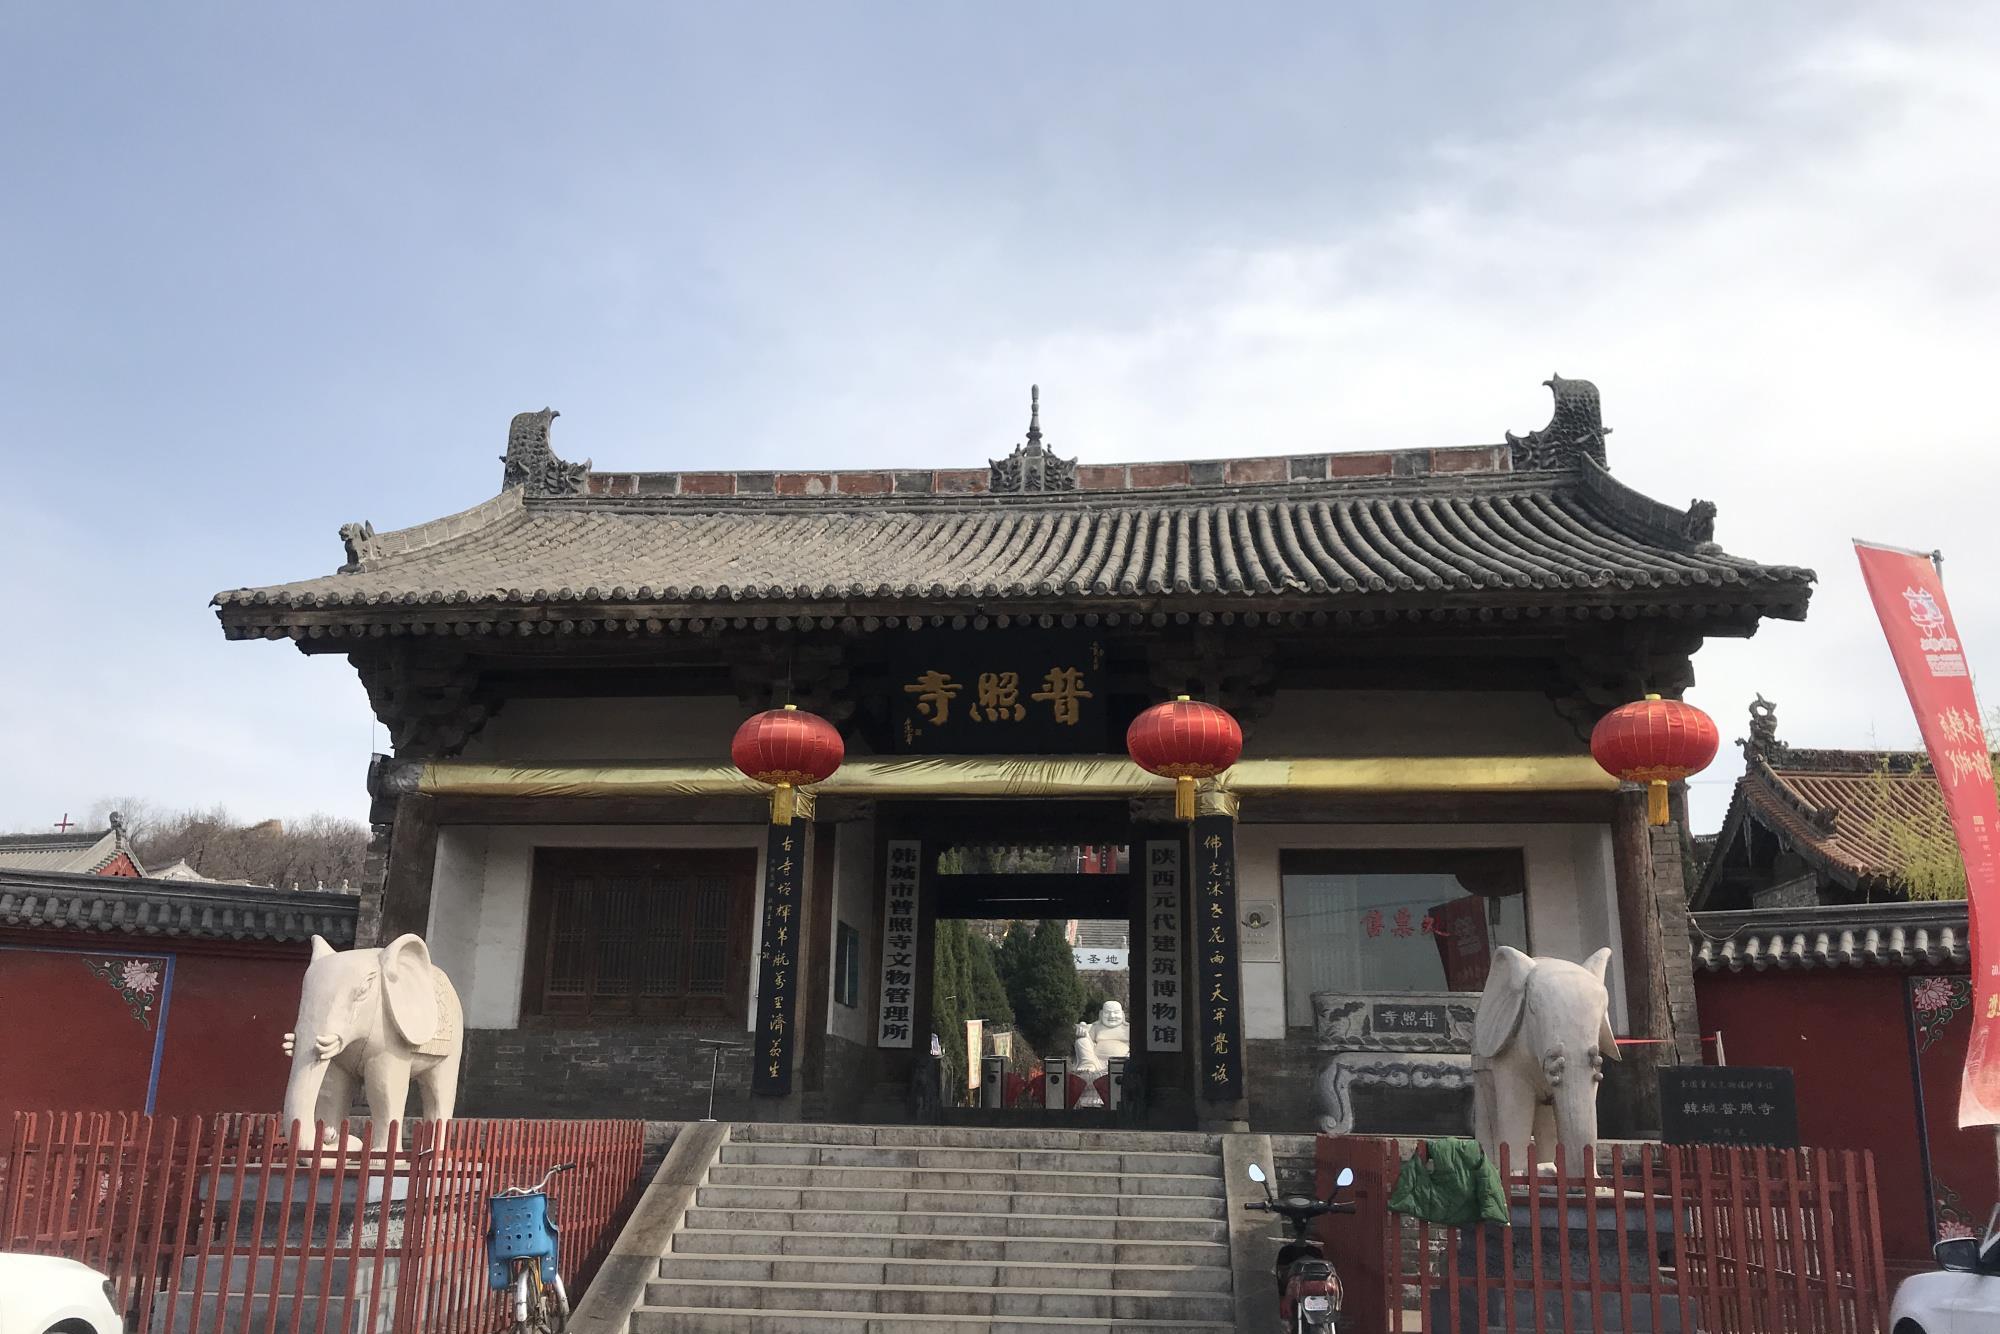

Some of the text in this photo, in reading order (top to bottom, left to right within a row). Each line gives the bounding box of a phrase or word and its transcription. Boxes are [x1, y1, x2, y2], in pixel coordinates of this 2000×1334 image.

[904, 666, 1093, 726] 普照寺
[882, 847, 918, 1041] 韩城市普照寺文物管理所
[1151, 848, 1178, 1044] 陕西元代建筑博物馆
